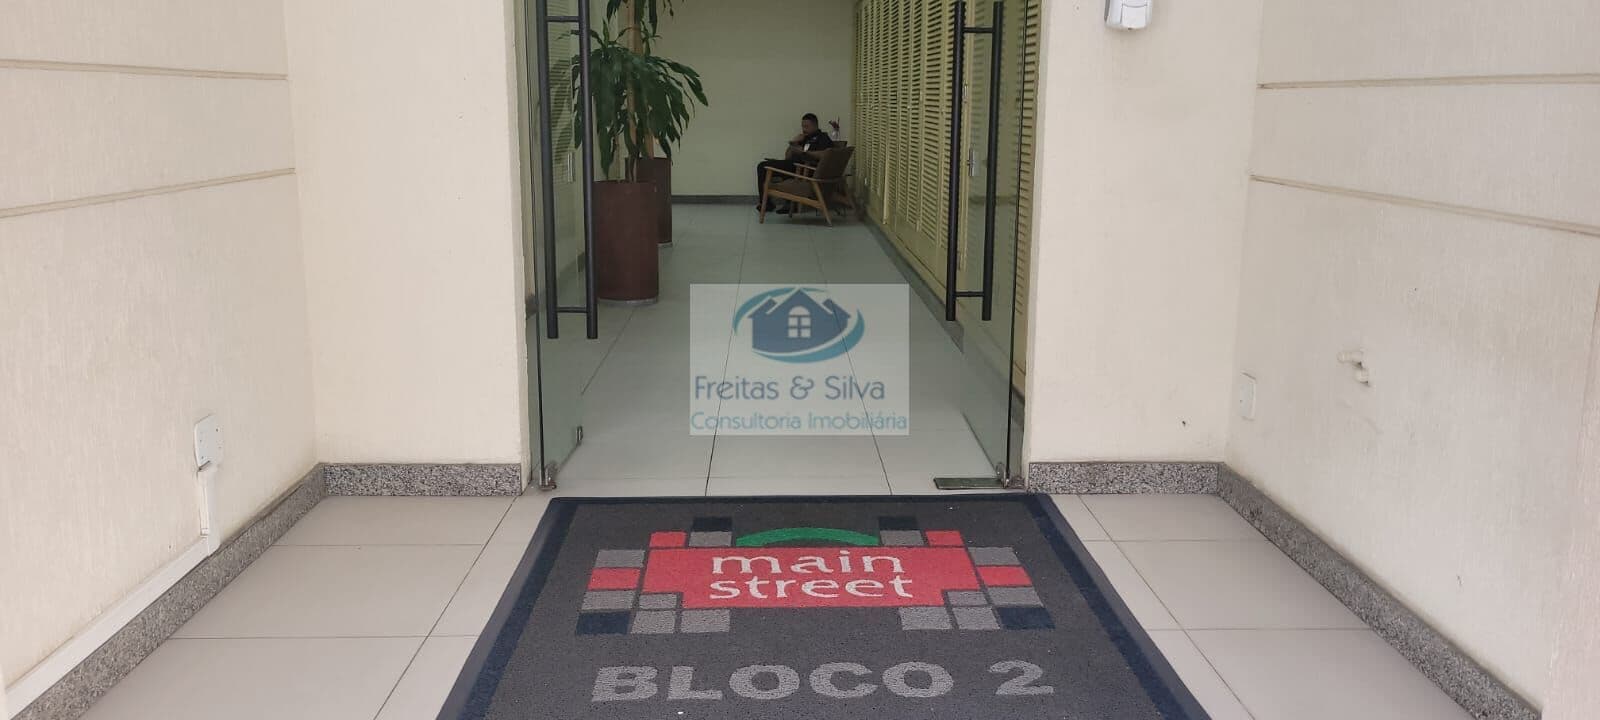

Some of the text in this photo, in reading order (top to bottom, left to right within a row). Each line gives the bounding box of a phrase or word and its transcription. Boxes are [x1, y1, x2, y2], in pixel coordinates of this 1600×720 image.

[712, 550, 904, 574] main
[709, 575, 913, 599] street
[591, 660, 1054, 701] BLOCO 2
